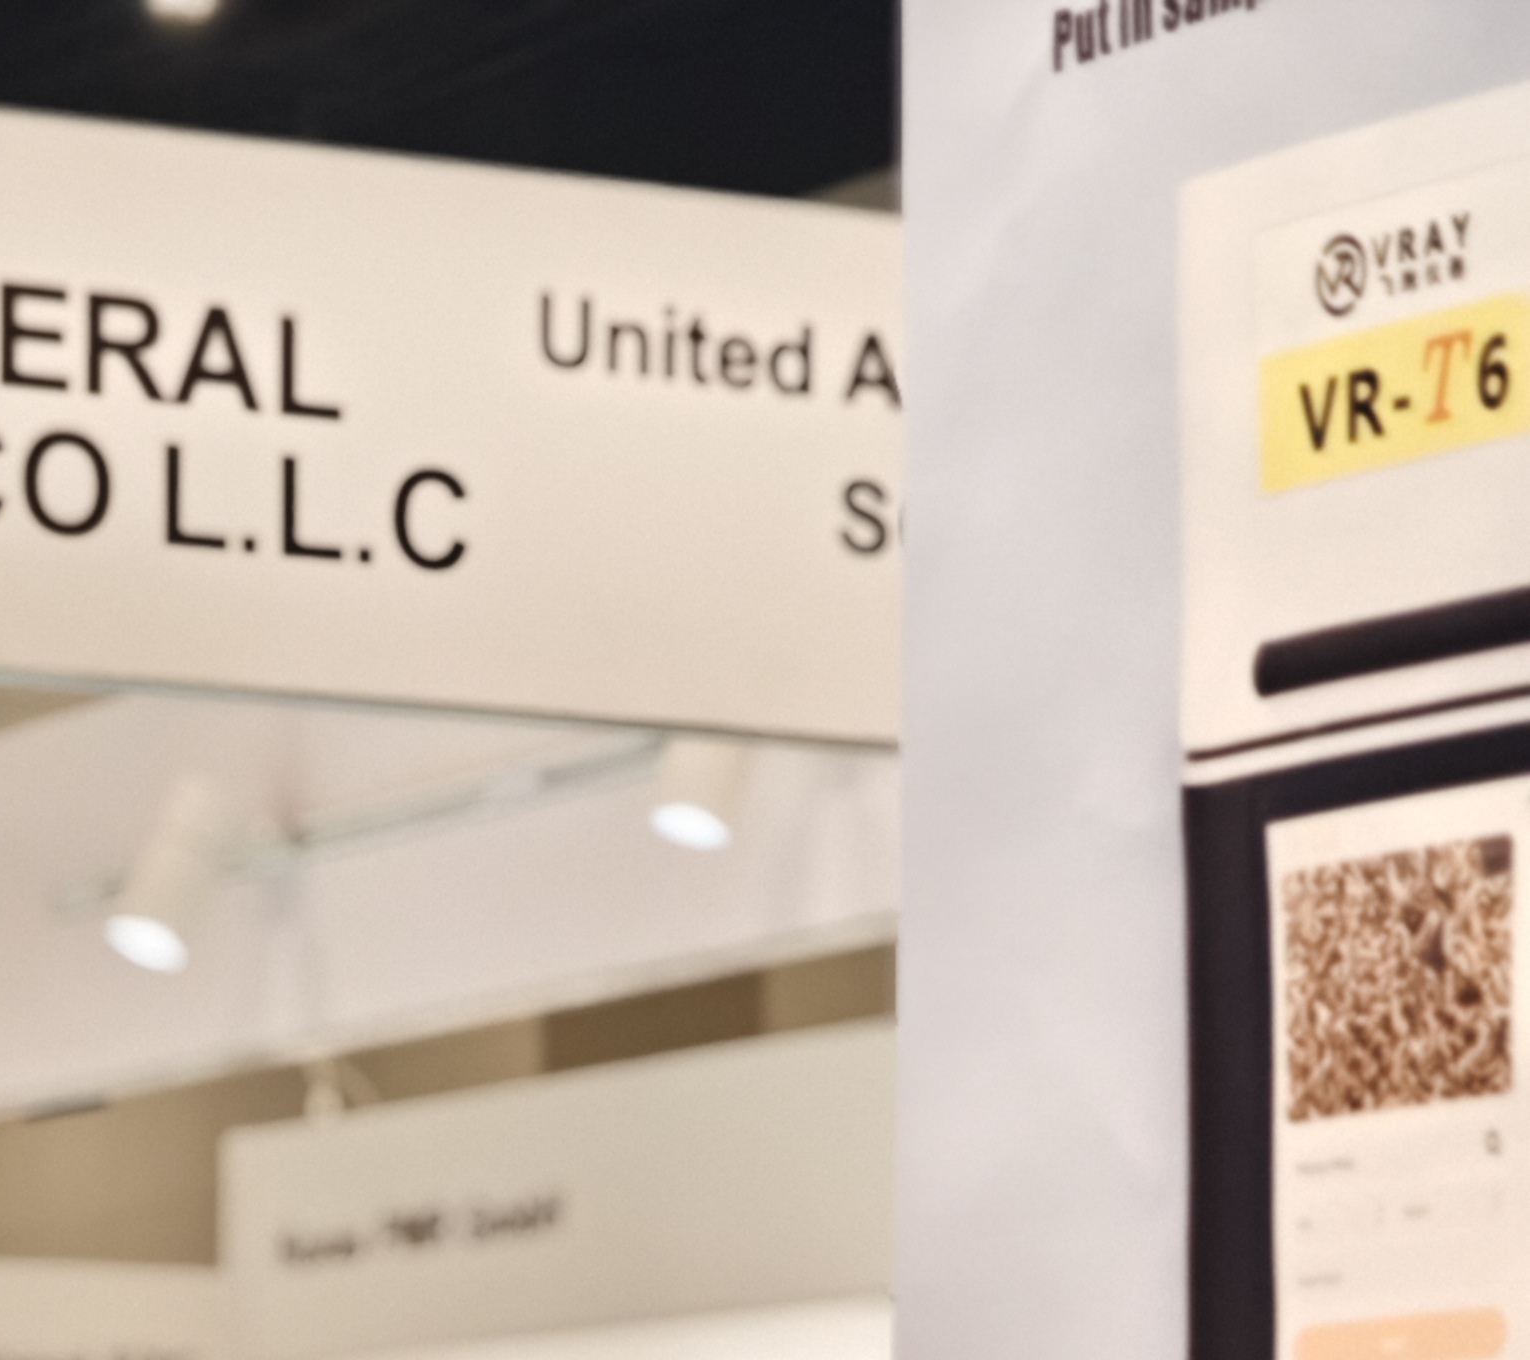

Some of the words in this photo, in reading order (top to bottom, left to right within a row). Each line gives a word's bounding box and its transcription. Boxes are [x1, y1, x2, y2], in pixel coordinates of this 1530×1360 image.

[1053, 0, 1111, 73] Put
[1371, 211, 1471, 268] VRAY
[539, 291, 814, 395] United
[844, 332, 902, 408] A
[1299, 329, 1510, 453] VR-T6
[166, 445, 467, 570] L.L.C
[841, 480, 904, 556] S
